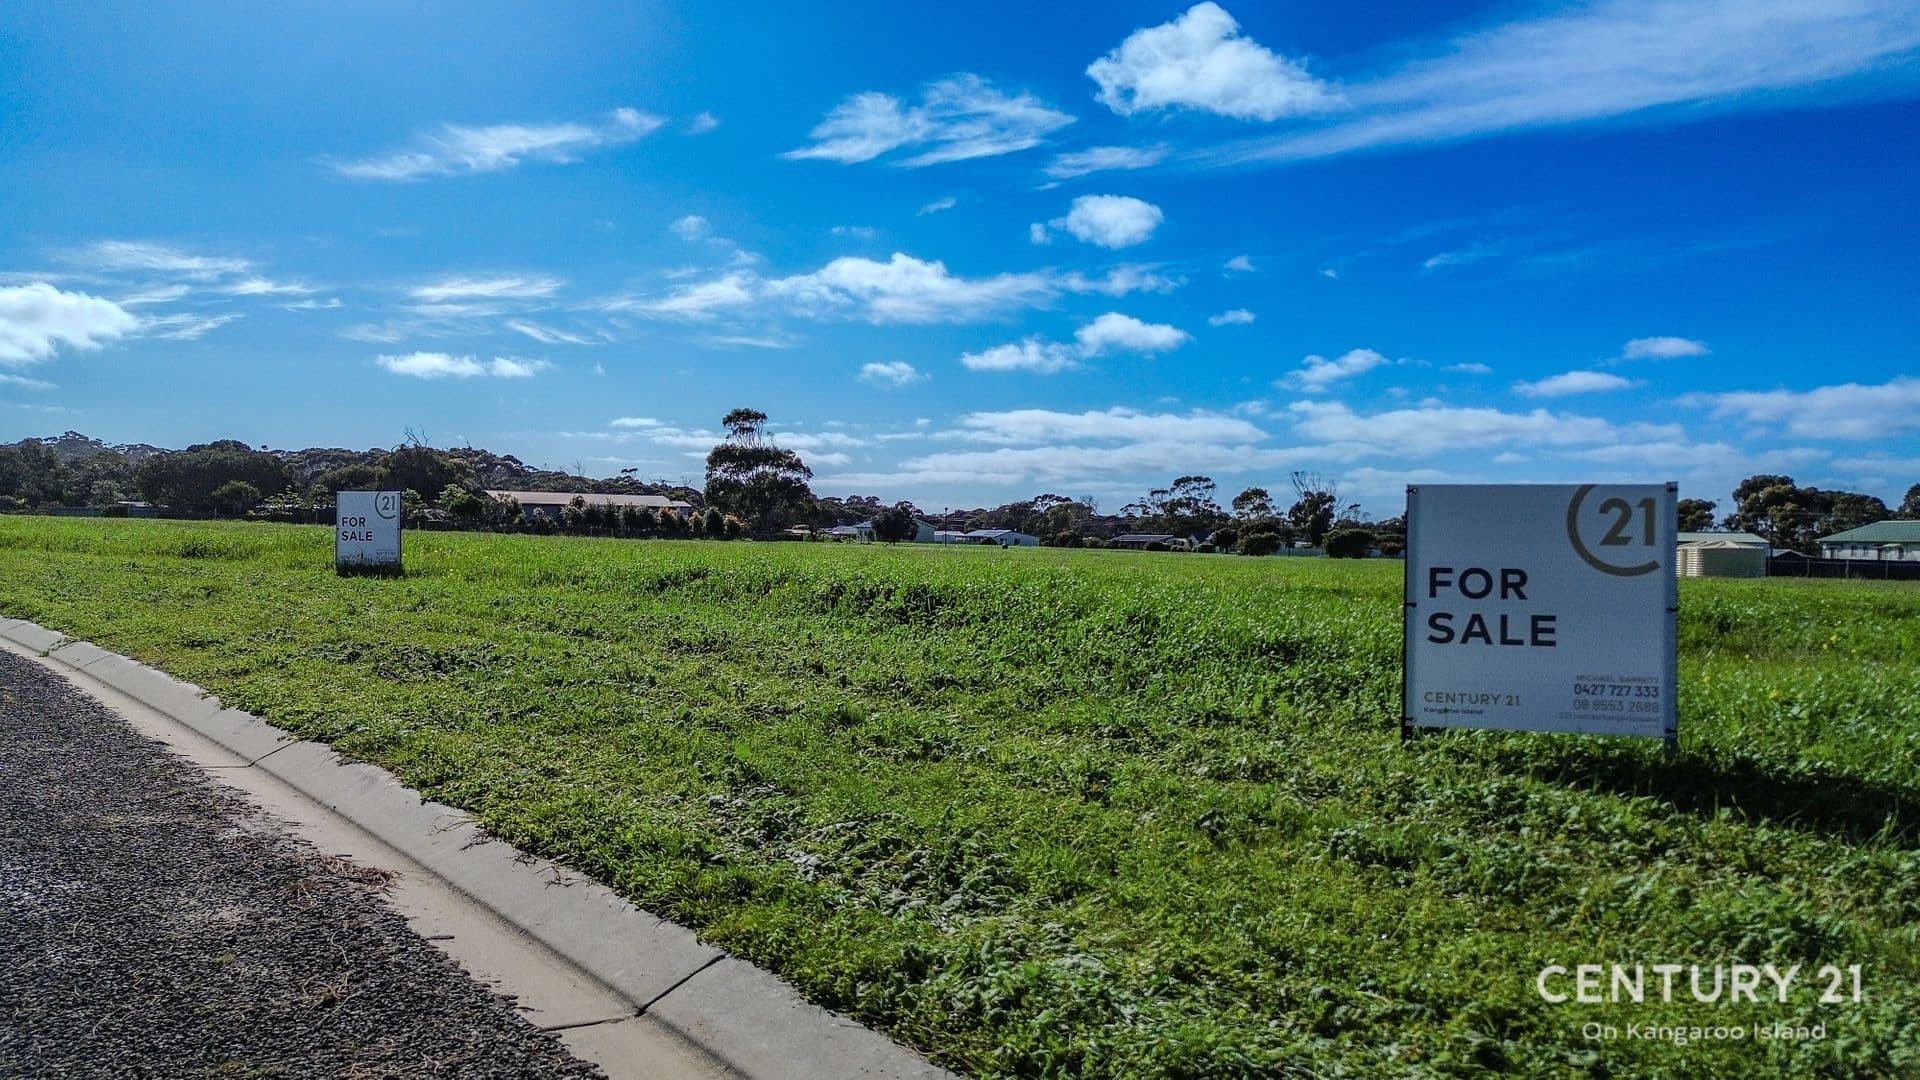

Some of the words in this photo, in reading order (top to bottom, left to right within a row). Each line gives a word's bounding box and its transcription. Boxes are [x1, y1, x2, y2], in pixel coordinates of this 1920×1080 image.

[382, 496, 396, 511] 21
[341, 517, 366, 528] FOR
[1597, 497, 1657, 546] 21
[341, 530, 373, 541] SALE
[1428, 567, 1528, 600] FOR
[1427, 612, 1557, 647] SALE
[1574, 683, 1605, 695] 0427
[1608, 685, 1631, 697] 727
[1635, 686, 1659, 698] 333
[1423, 691, 1501, 705] CENTURY
[1505, 694, 1520, 706] 21
